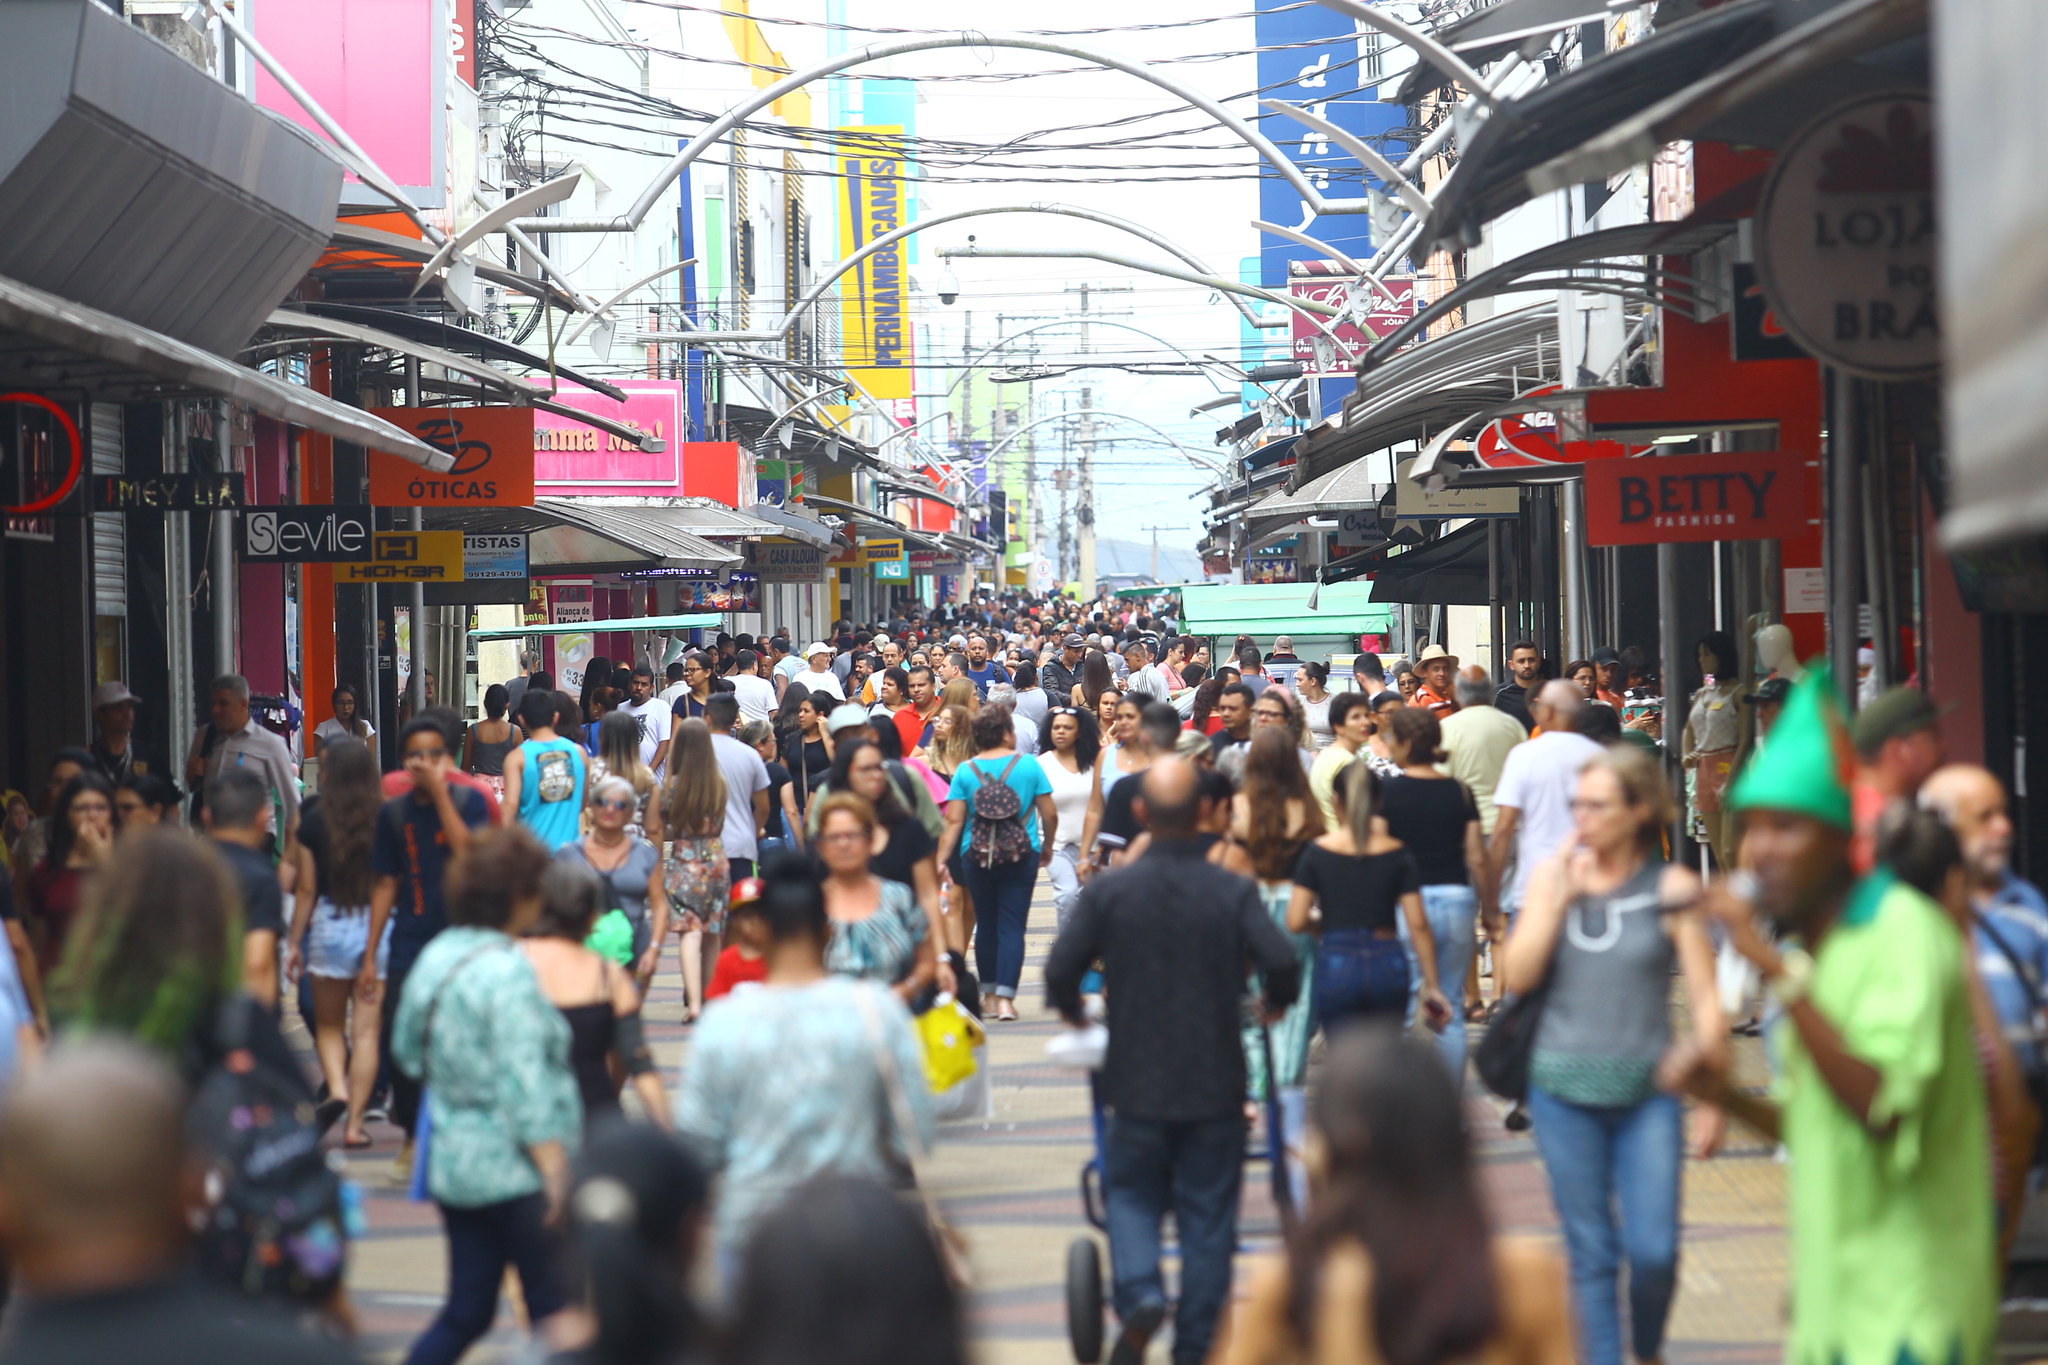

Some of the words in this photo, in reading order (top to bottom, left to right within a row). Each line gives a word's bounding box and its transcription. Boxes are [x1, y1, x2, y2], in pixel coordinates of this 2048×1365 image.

[407, 477, 497, 499] ÓTICAS
[1619, 471, 1776, 524] BETTY
[1655, 514, 1736, 527] FASHION
[247, 512, 366, 555] Sevile
[556, 606, 580, 616] Aliança
[581, 607, 590, 615] de
